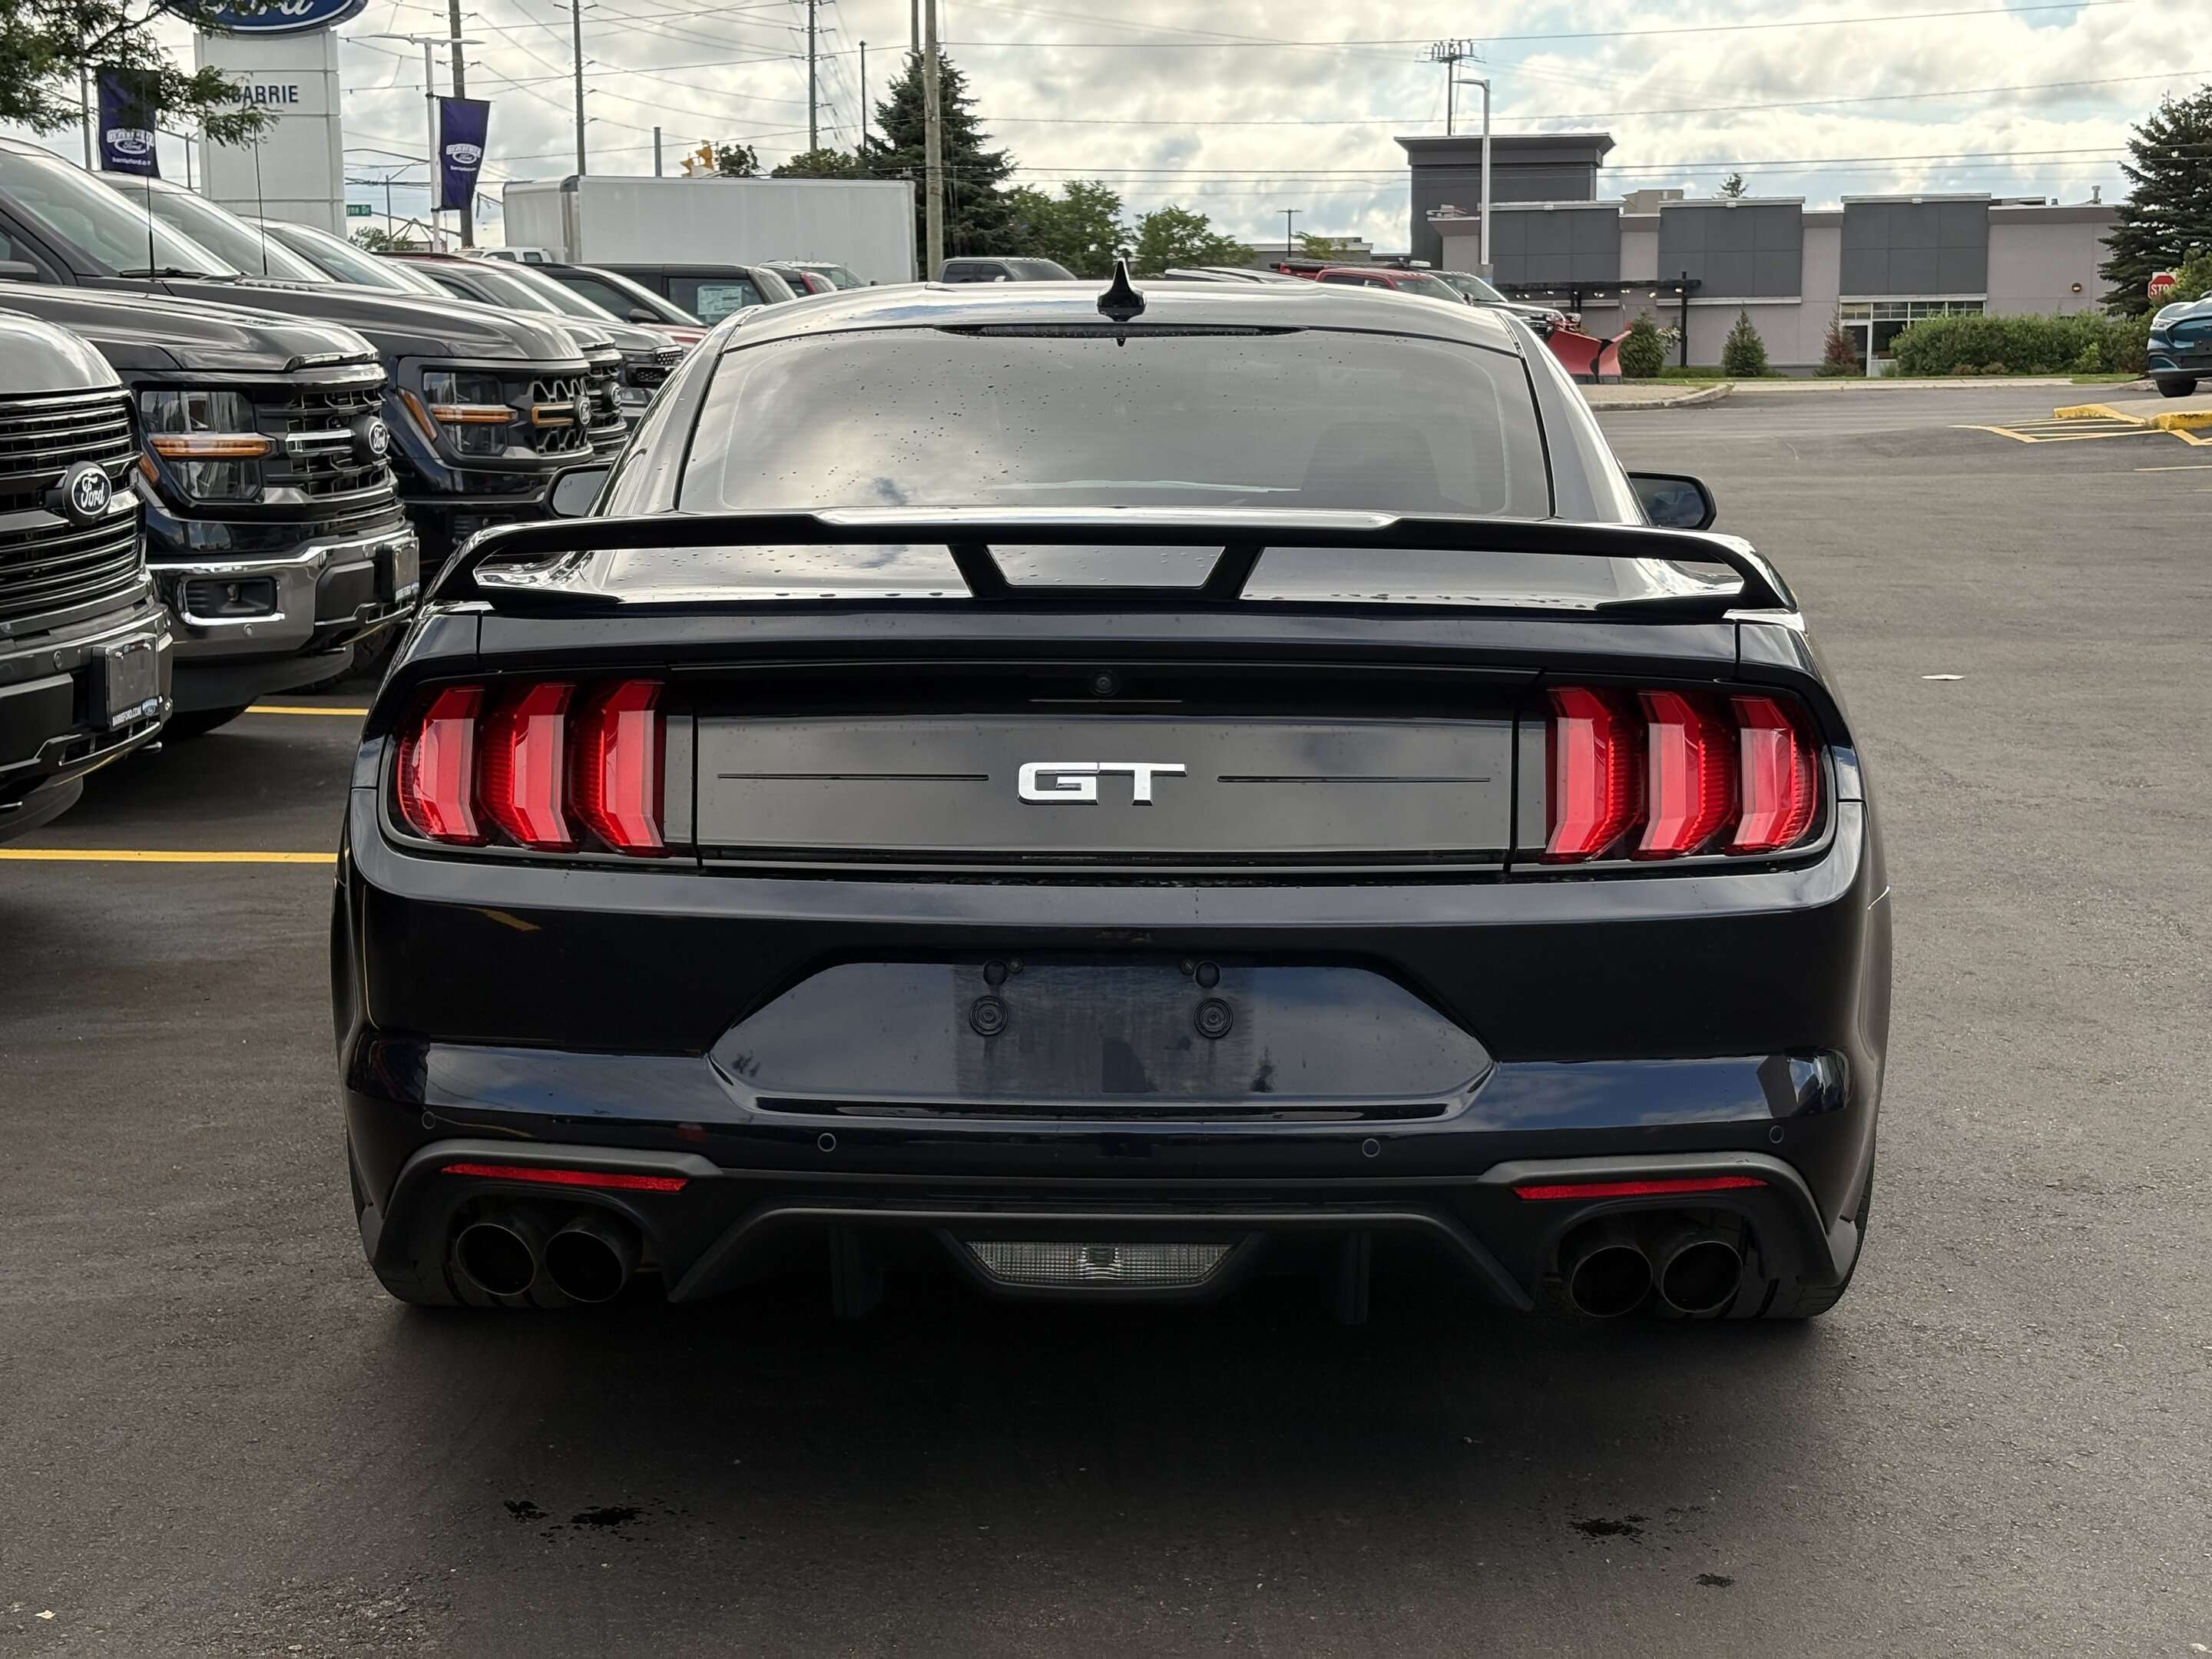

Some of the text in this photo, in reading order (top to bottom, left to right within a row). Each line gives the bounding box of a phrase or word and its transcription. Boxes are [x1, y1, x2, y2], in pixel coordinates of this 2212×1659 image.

[2151, 284, 2176, 295] STO
[81, 476, 105, 508] Ford
[1018, 762, 1187, 806] GT
